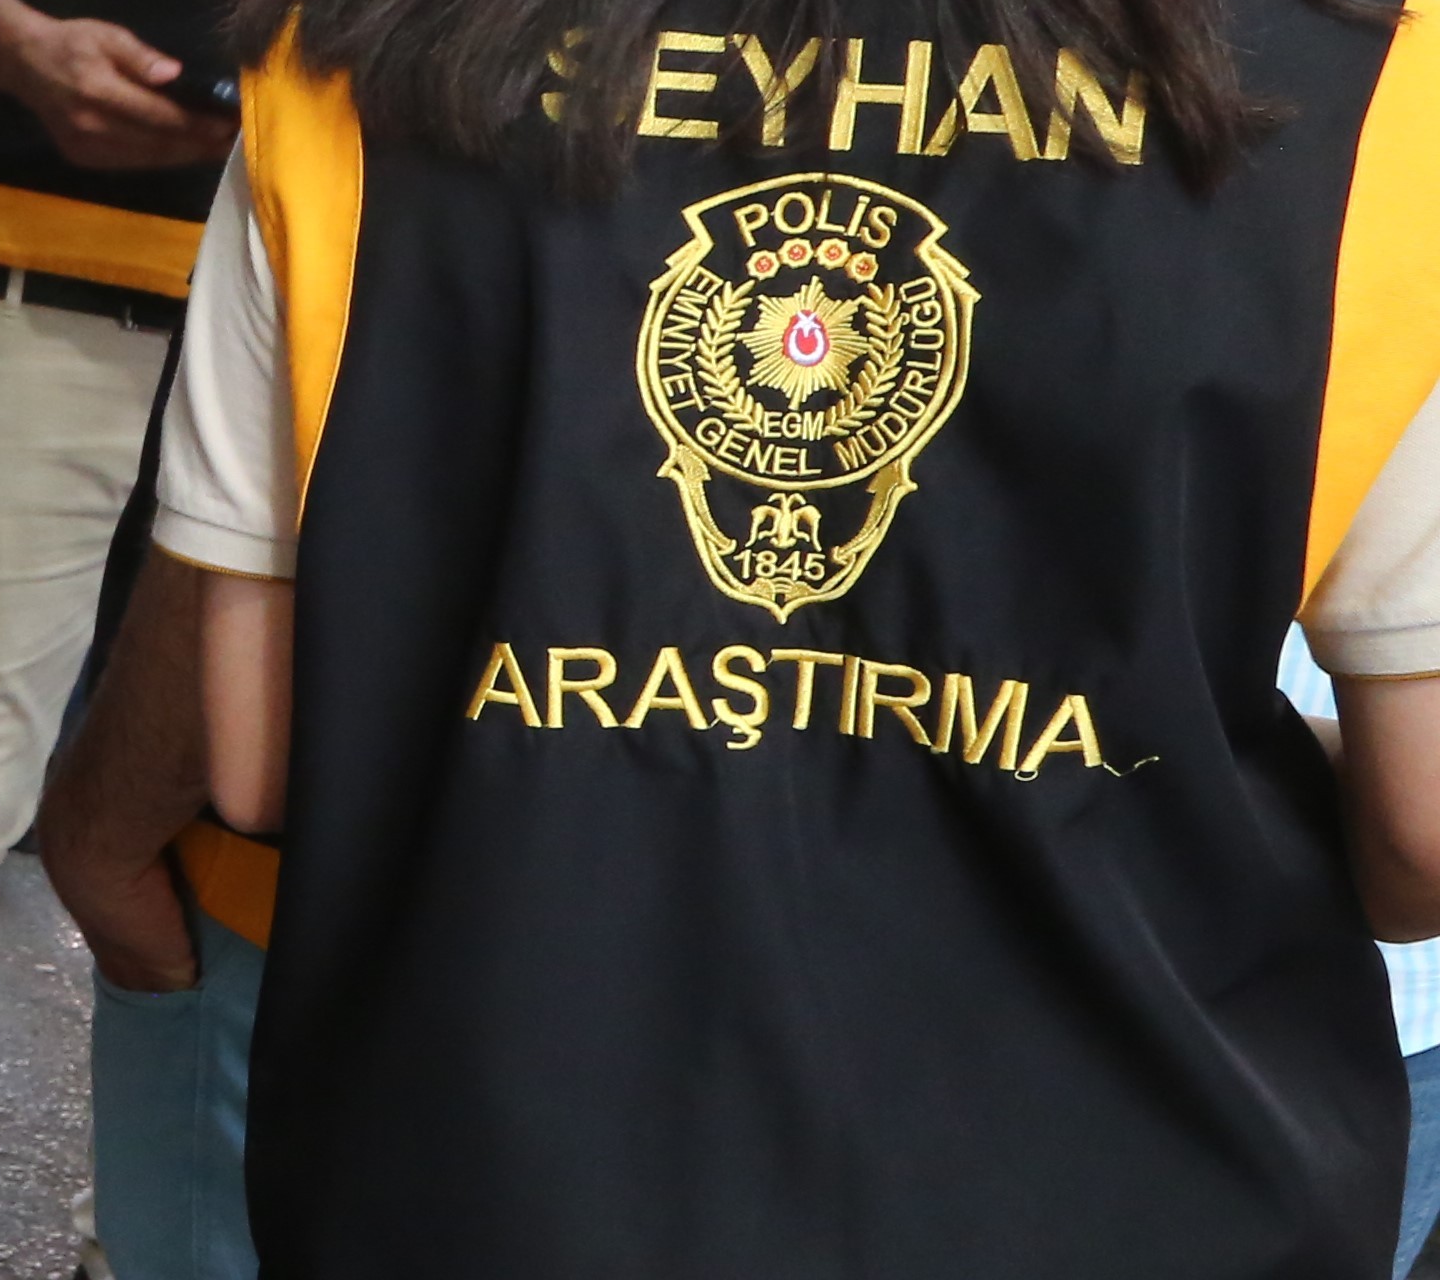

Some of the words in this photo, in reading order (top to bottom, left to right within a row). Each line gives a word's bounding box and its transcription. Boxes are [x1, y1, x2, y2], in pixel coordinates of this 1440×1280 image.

[734, 189, 898, 249] POLİS
[658, 266, 724, 413] EMNİYET
[694, 417, 822, 476] GENEL
[764, 410, 824, 441] EGM
[735, 549, 825, 580] 1845
[466, 642, 1102, 772] ARAŞTIRMA
